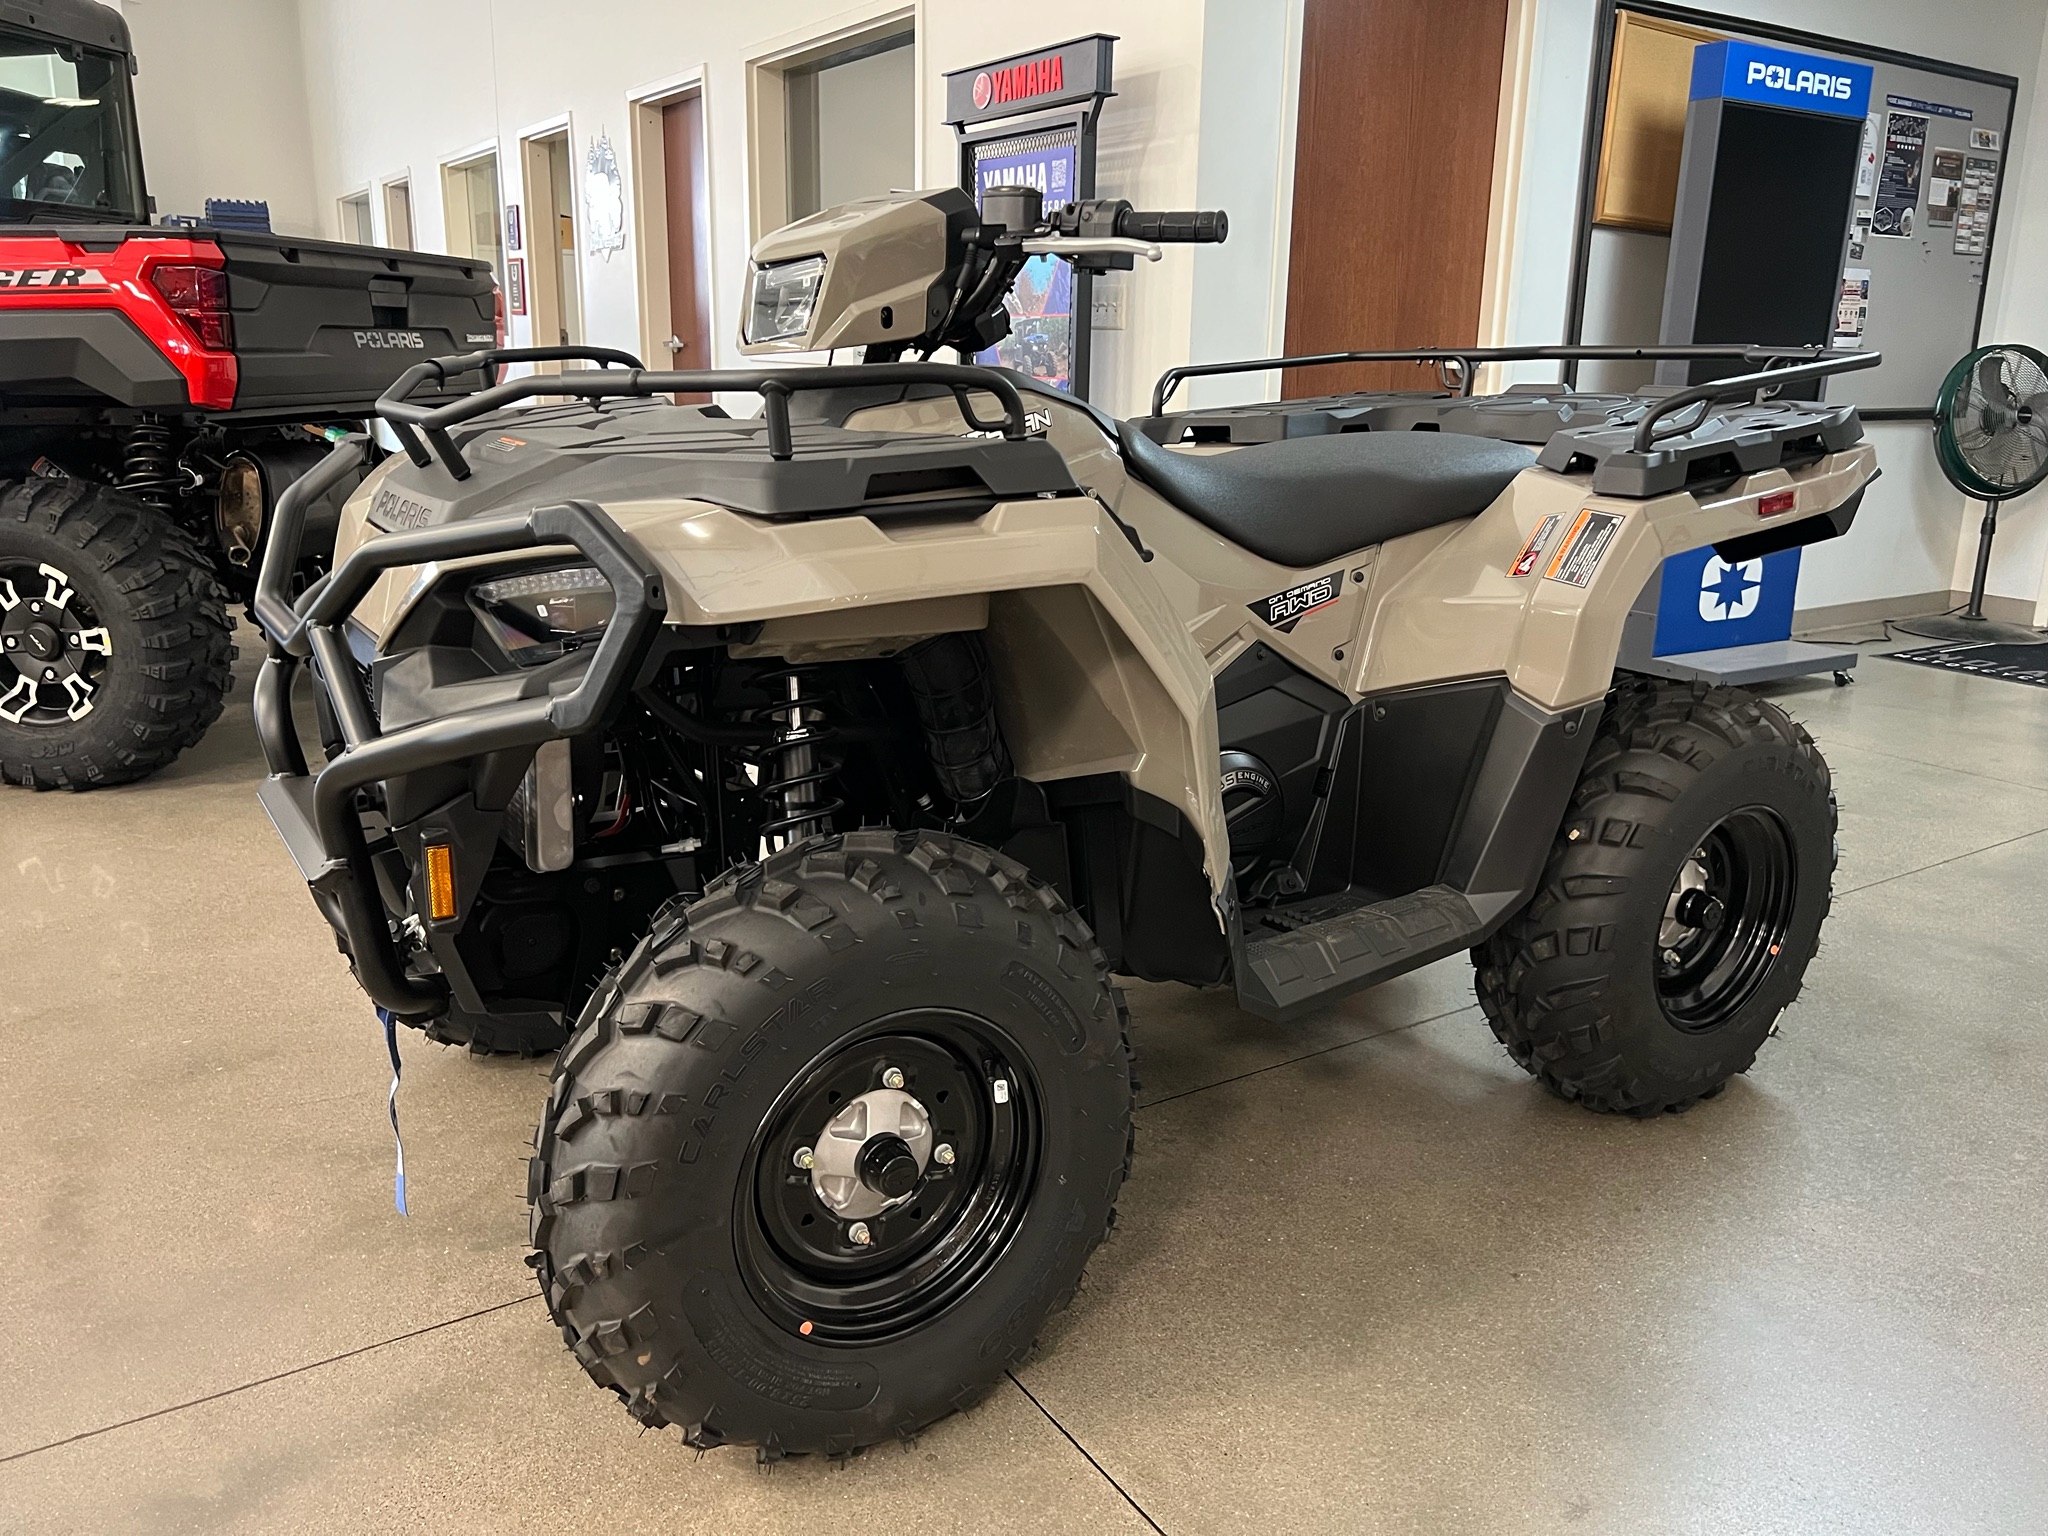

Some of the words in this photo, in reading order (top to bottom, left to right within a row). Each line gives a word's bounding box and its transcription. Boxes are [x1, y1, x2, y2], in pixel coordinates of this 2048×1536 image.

[992, 55, 1063, 104] YAMAHA
[1747, 61, 1852, 100] POLARIS
[983, 162, 1047, 194] YAMAHA
[353, 331, 424, 349] POLARIS
[376, 490, 432, 528] POLARIS
[1268, 594, 1283, 605] ON
[1286, 577, 1331, 598] DEMAND
[1270, 584, 1333, 622] AWD
[1237, 771, 1269, 789] ENGINE
[678, 977, 834, 1165] CARLSTAR
